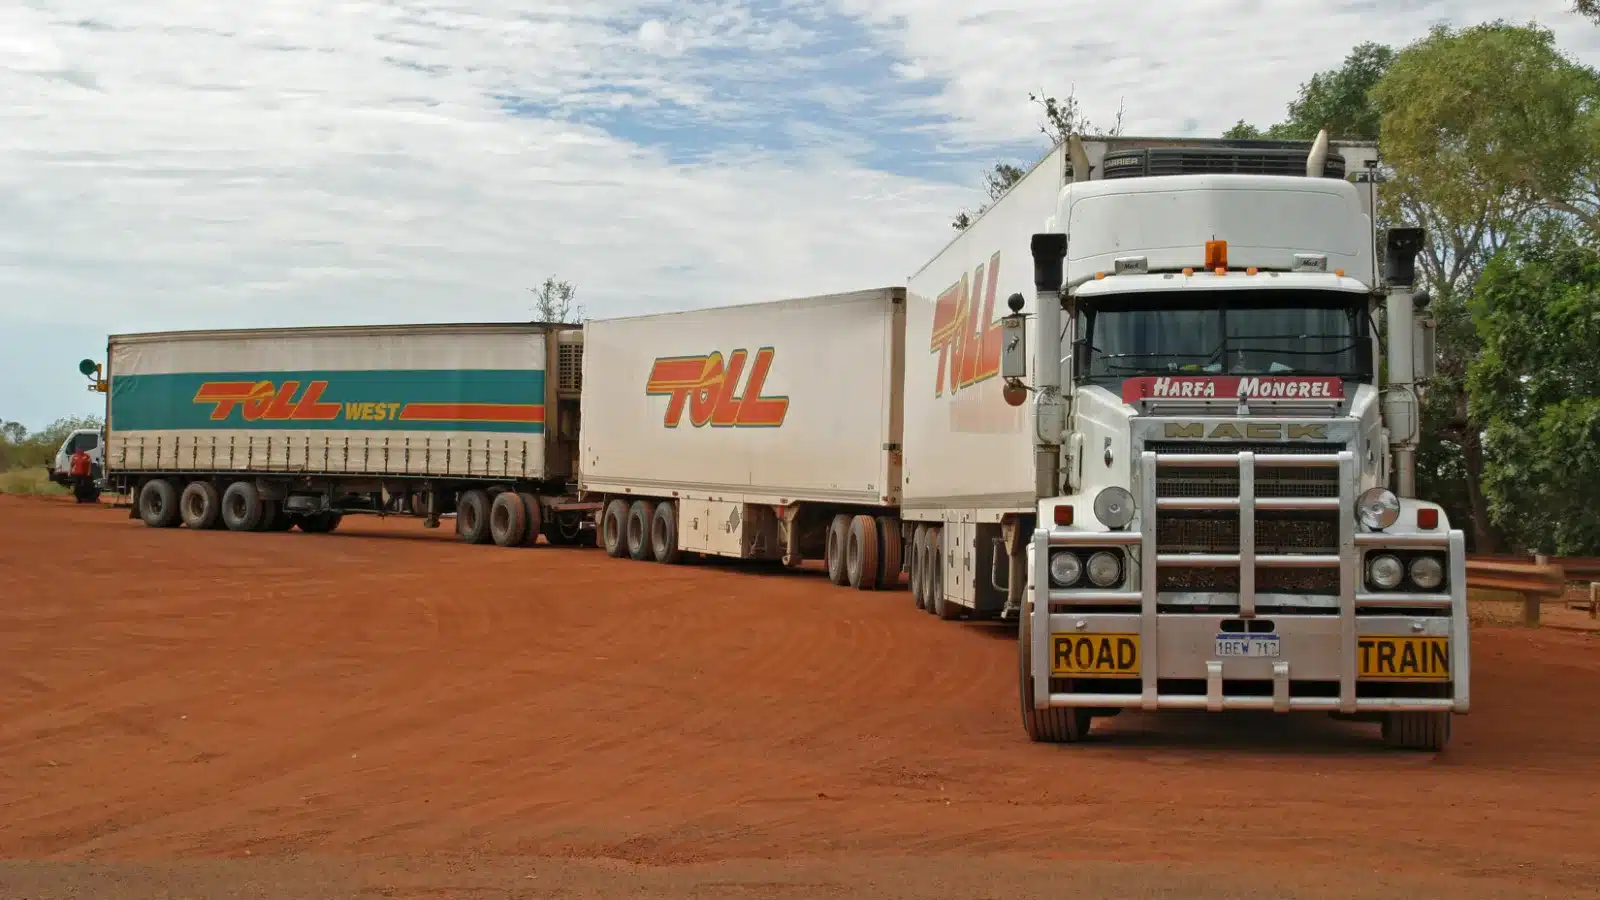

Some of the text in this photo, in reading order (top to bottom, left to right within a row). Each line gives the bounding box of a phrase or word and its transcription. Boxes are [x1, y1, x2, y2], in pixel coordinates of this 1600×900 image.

[1104, 157, 1139, 168] CARRIER
[930, 249, 1003, 400] TOLL
[193, 380, 401, 421] TOLL WEST
[645, 346, 789, 428] TOLL
[1152, 377, 1332, 397] HARFA MONGREL
[1164, 422, 1329, 440] MACK
[1054, 637, 1136, 670] ROAD
[1357, 640, 1449, 673] TRAIN
